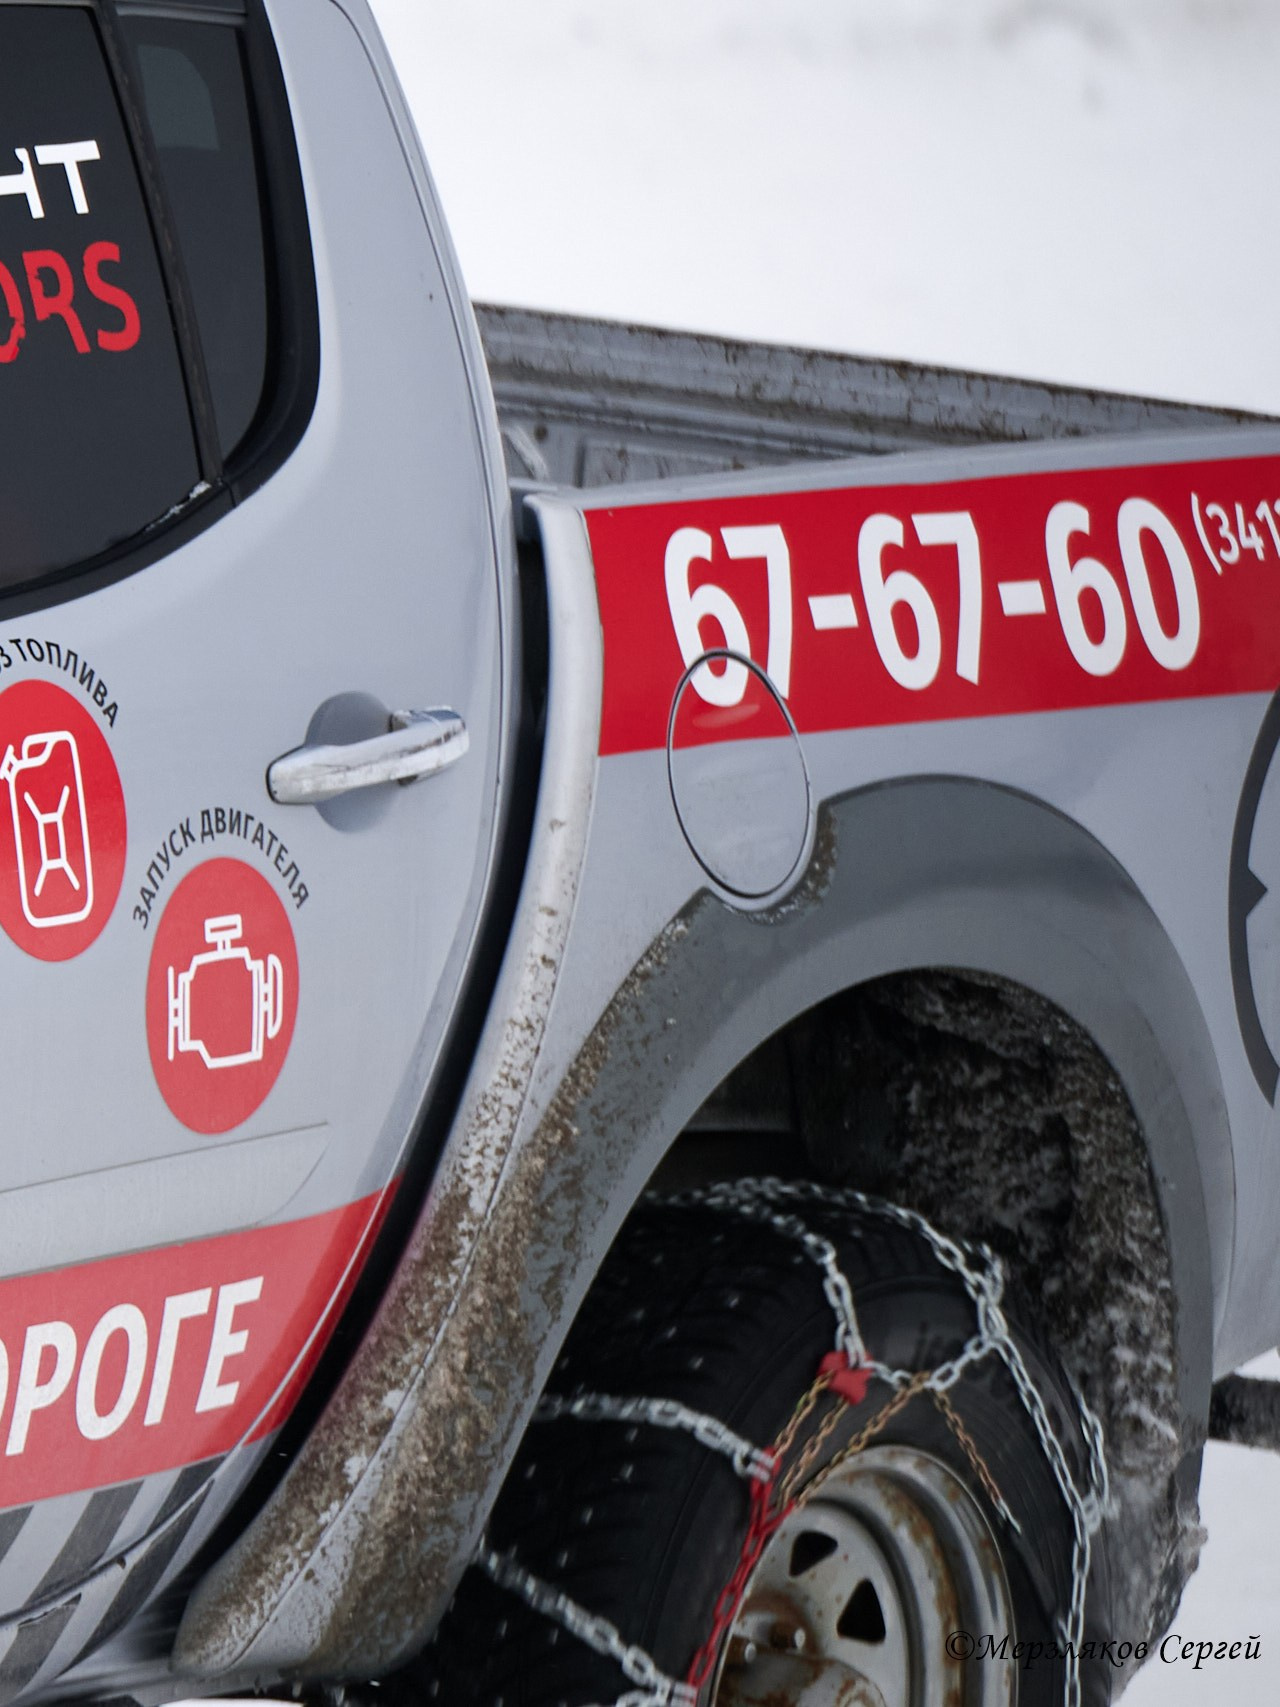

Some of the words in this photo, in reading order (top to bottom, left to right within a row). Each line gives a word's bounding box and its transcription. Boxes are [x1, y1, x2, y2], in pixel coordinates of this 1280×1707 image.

[664, 497, 1201, 707] 67-67-60
[1191, 491, 1280, 576] (341
[10, 638, 120, 729] ТОПЛИВА
[133, 817, 196, 930] ЗАПУСК
[200, 807, 310, 911] ДВИГАТЕЛЯ
